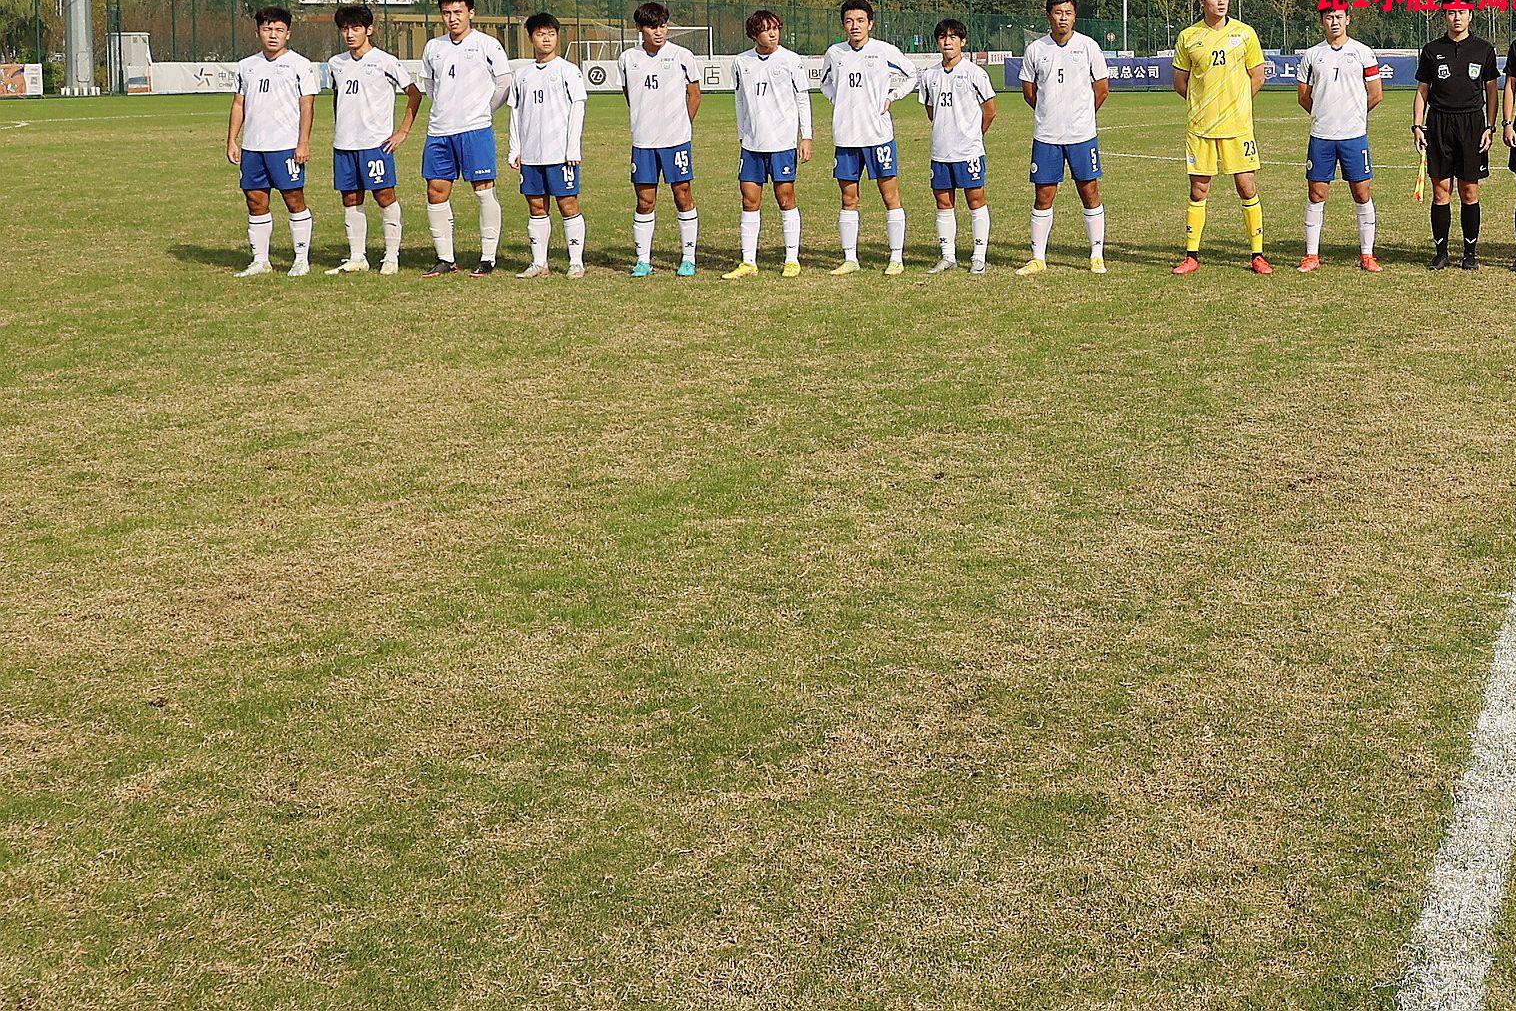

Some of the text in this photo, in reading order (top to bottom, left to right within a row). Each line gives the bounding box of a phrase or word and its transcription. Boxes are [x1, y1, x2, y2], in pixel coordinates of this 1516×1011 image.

[1211, 49, 1226, 66] 23
[448, 64, 455, 79] 4
[704, 65, 721, 85] 店
[1057, 68, 1064, 83] 5
[1333, 67, 1339, 82] 7
[259, 78, 270, 93] 10
[345, 79, 359, 95] 20
[645, 74, 659, 90] 45
[849, 72, 862, 88] 82
[533, 89, 544, 104] 19
[756, 82, 767, 96] 17
[940, 92, 953, 107] 33
[876, 146, 892, 164] 82
[1090, 147, 1097, 164] 5
[1243, 141, 1256, 157] 23
[674, 150, 689, 169] 45
[966, 157, 981, 173] 33
[367, 159, 385, 178] 20
[562, 165, 575, 182] 19
